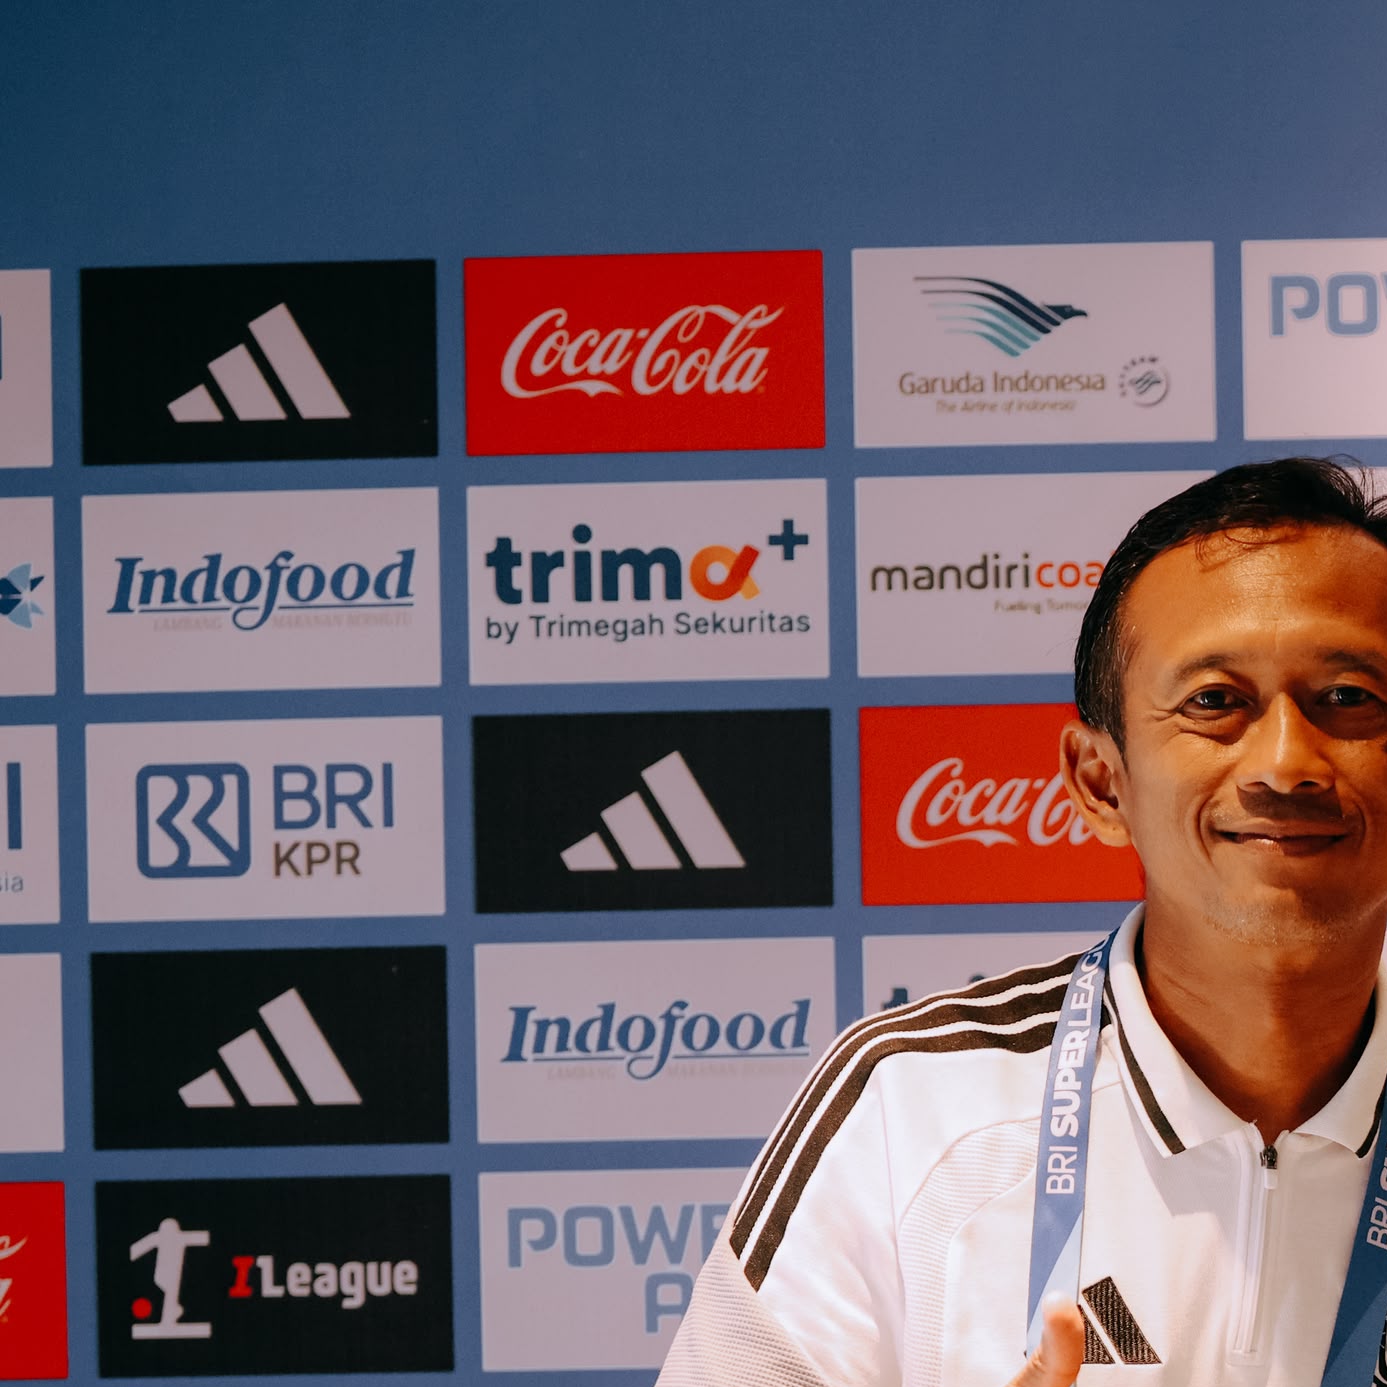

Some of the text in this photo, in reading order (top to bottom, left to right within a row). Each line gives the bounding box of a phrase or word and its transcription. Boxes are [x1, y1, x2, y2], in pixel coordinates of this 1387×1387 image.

[500, 303, 785, 398] Coca-Cola
[899, 371, 984, 396] Garuda
[993, 370, 1106, 394] Indonesia
[107, 547, 417, 632] Indofood
[871, 552, 1102, 593] mandiricoa
[485, 609, 811, 643] by Trimegah Sekuritas
[271, 761, 394, 831] BRI
[272, 841, 362, 877] KPR
[500, 998, 811, 1081] Indofood
[1045, 1145, 1078, 1195] BRI
